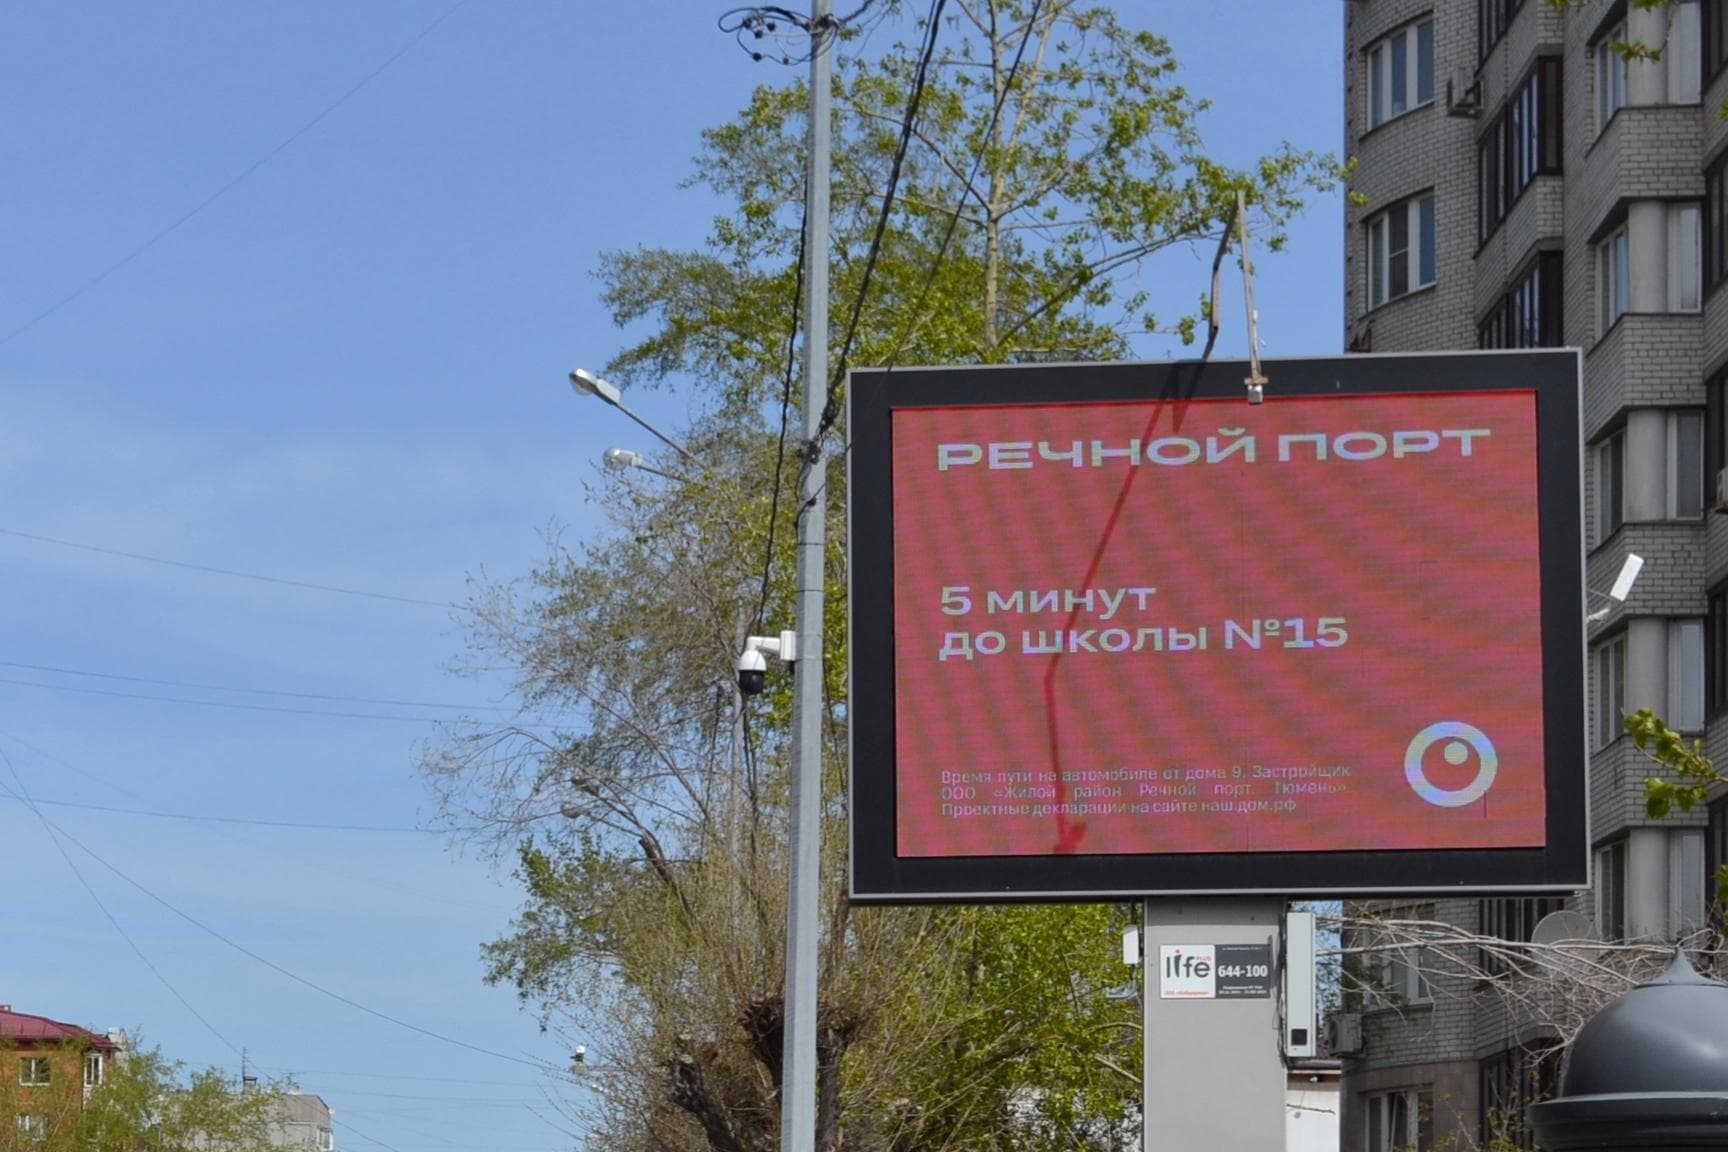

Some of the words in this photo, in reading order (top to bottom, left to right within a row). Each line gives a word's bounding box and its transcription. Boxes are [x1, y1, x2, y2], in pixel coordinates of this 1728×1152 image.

[937, 427, 1256, 471] РЕЧНОЙ
[1278, 428, 1491, 462] ПОРТ
[941, 586, 971, 615] 5
[987, 587, 1157, 619] минут
[939, 629, 1006, 661] до
[1022, 627, 1207, 654] школы
[1224, 617, 1348, 650] №15
[942, 770, 992, 786] Время
[997, 771, 1032, 784] пути
[1062, 767, 1158, 781] автомобиле
[1163, 768, 1180, 780] от
[1253, 764, 1352, 779] Застройщик
[941, 786, 976, 800] ООО
[1074, 783, 1122, 800] район
[1139, 782, 1197, 797] Речной
[942, 802, 1031, 818] Проектные
[1032, 801, 1131, 817] декларации
[1153, 799, 1198, 813] сайте
[1165, 949, 1211, 978] life
[1217, 964, 1268, 978] 644-100
